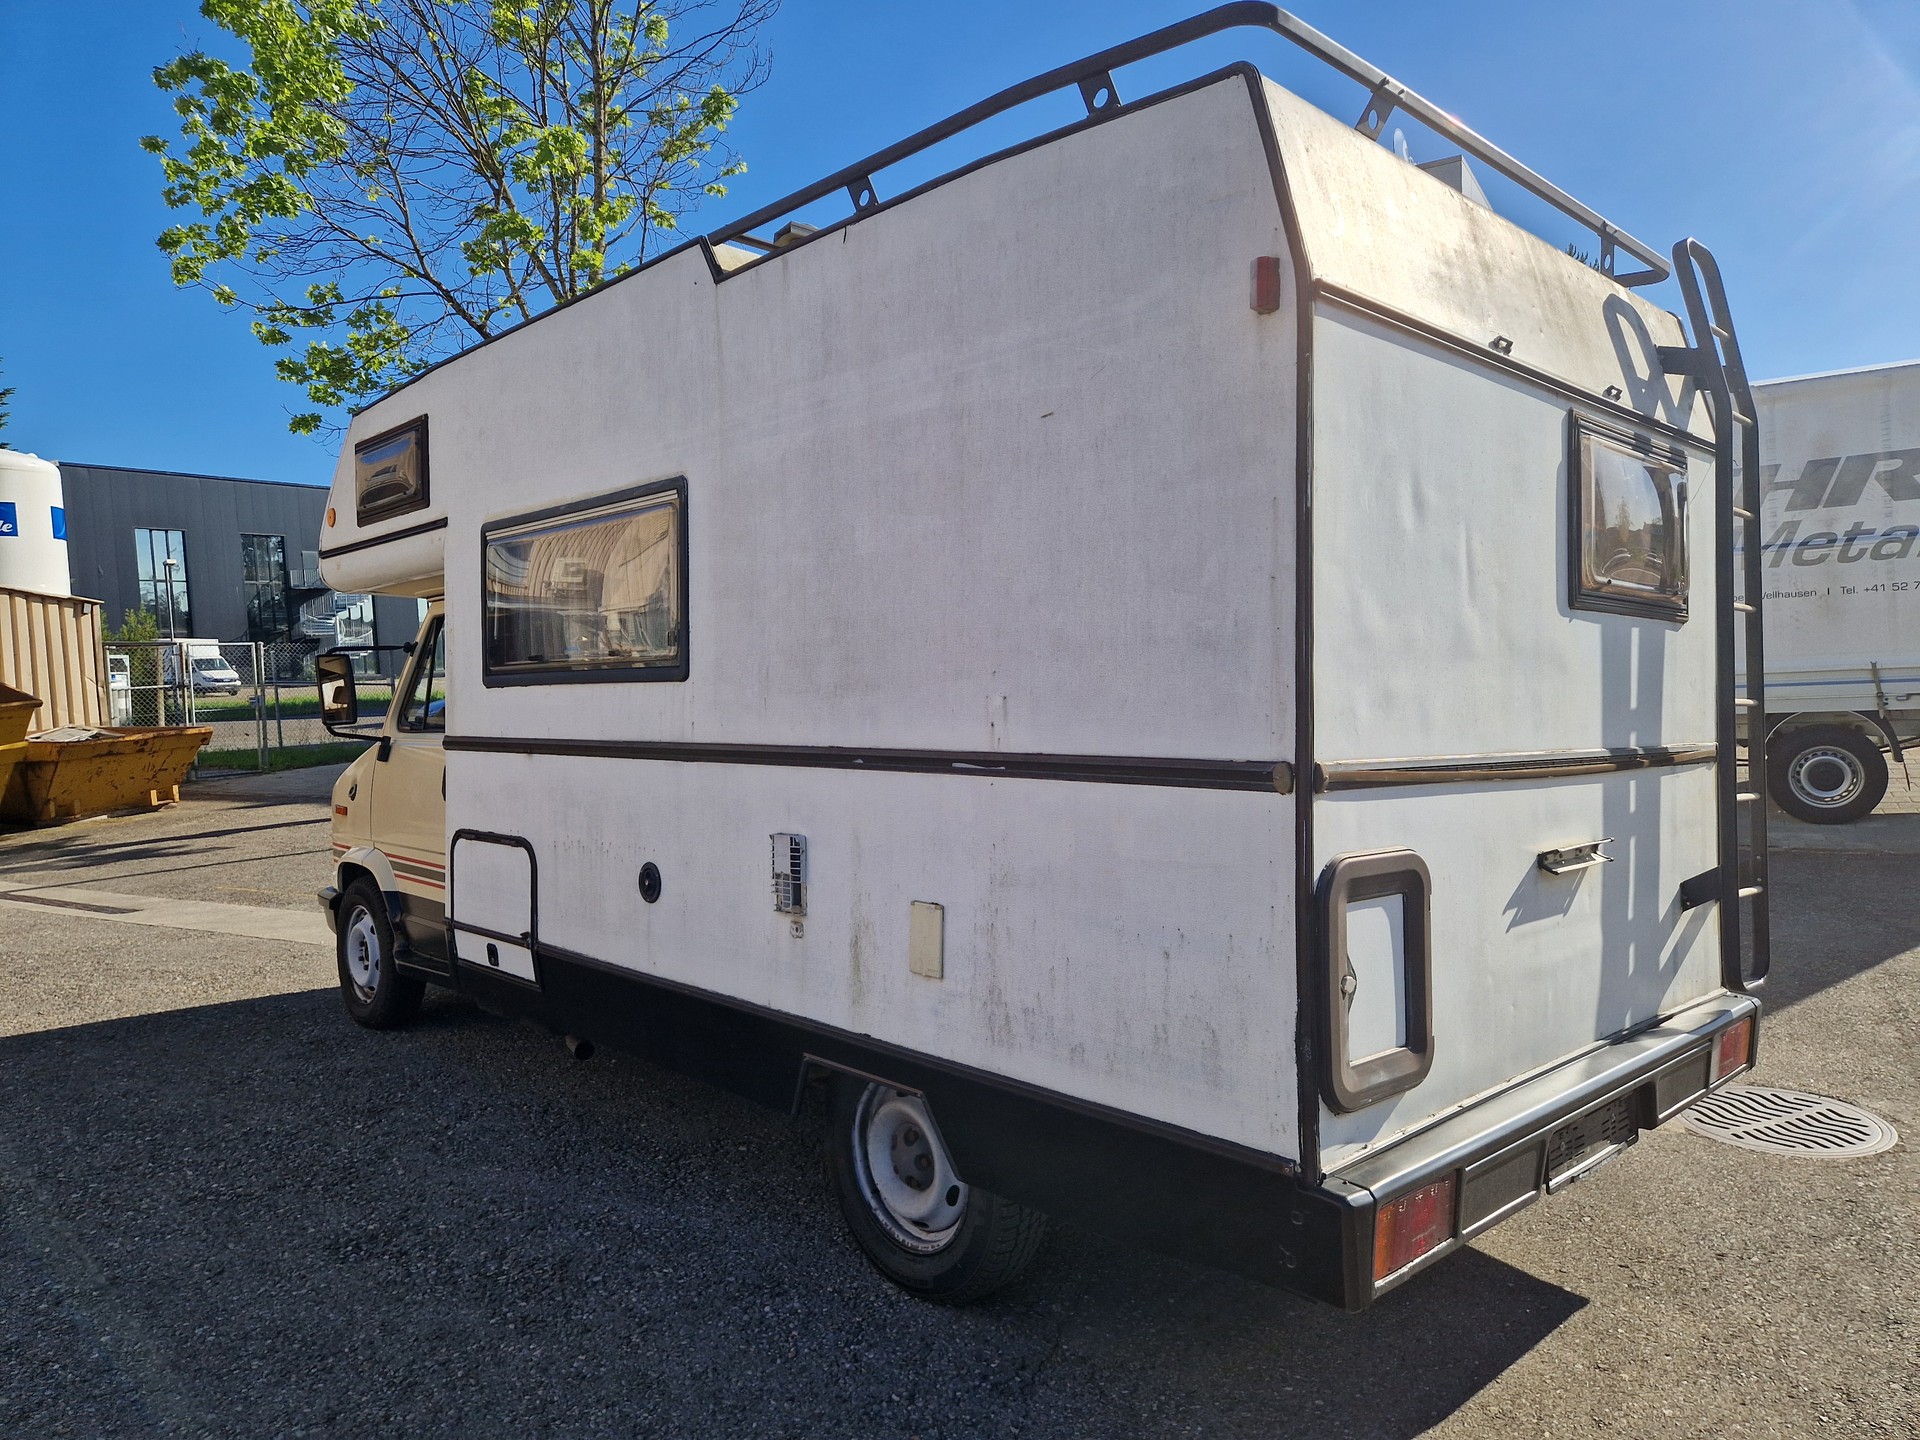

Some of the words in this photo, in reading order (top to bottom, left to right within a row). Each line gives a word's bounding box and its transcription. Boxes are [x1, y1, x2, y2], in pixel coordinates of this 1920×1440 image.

[1840, 586, 1858, 595] Tel.
[1864, 583, 1886, 593] +41
[1891, 582, 1908, 592] 52
